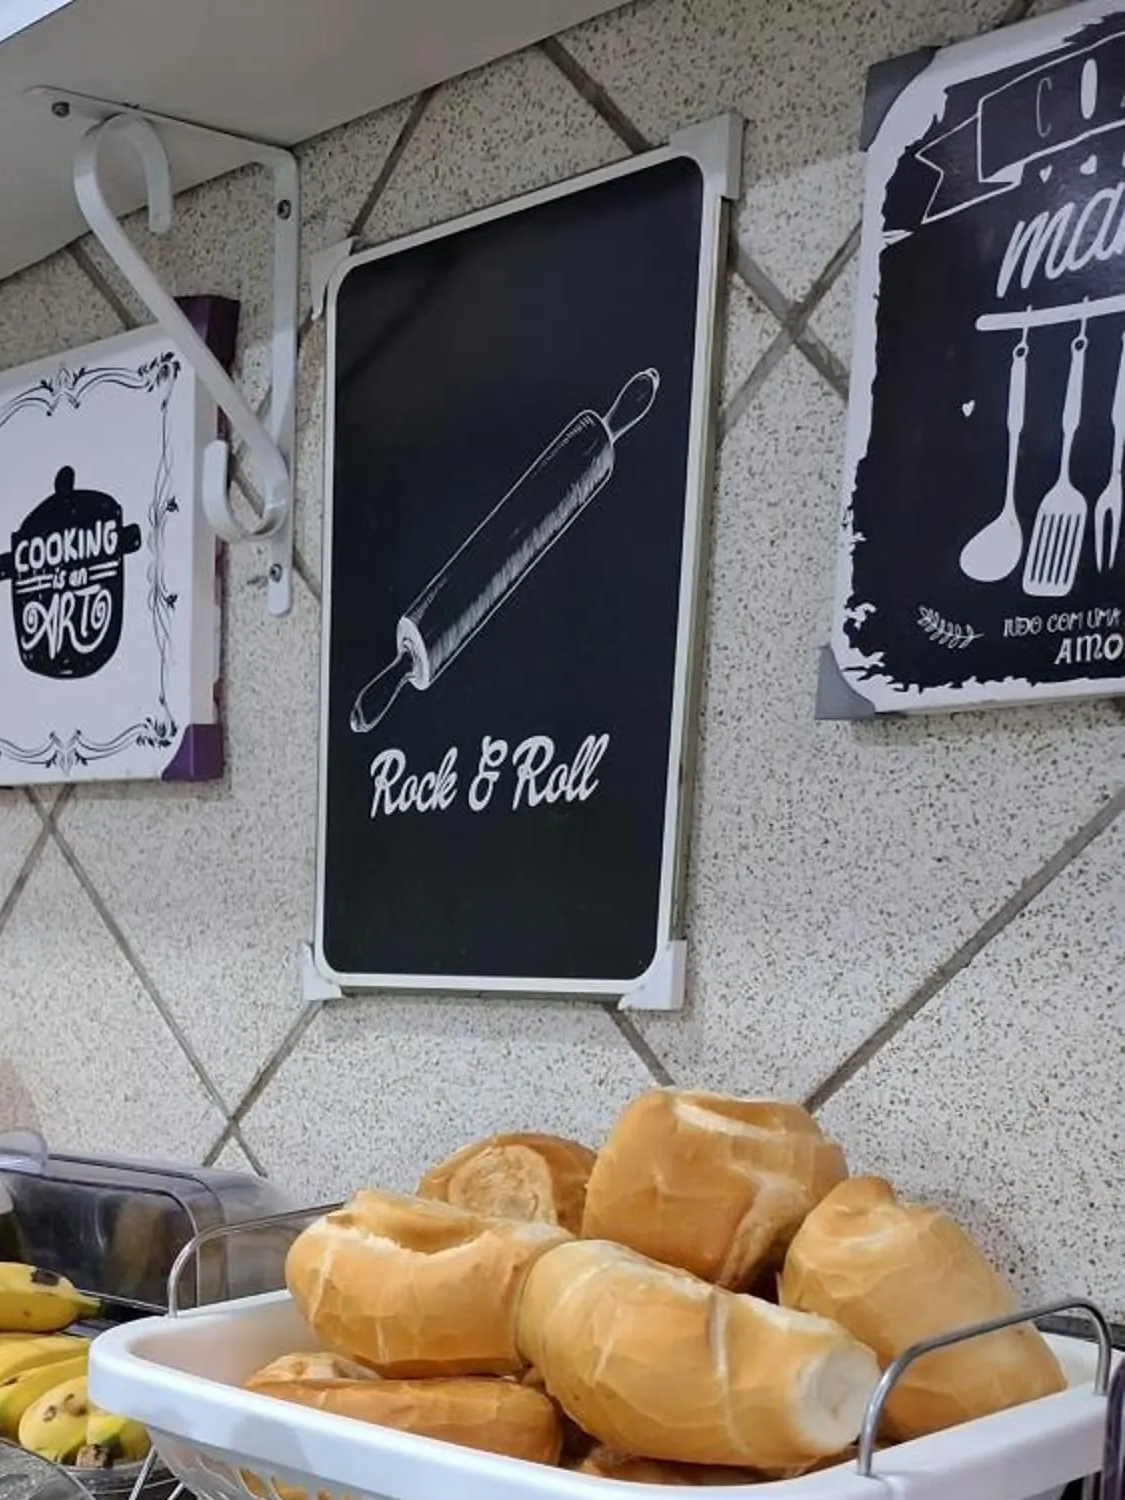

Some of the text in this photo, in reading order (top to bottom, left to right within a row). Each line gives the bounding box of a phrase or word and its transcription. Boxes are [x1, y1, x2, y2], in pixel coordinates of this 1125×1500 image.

[996, 182, 1125, 298] ma
[14, 520, 118, 573] COOKING
[52, 567, 88, 589] is an
[370, 747, 458, 818] Rock
[512, 733, 610, 811] Roll
